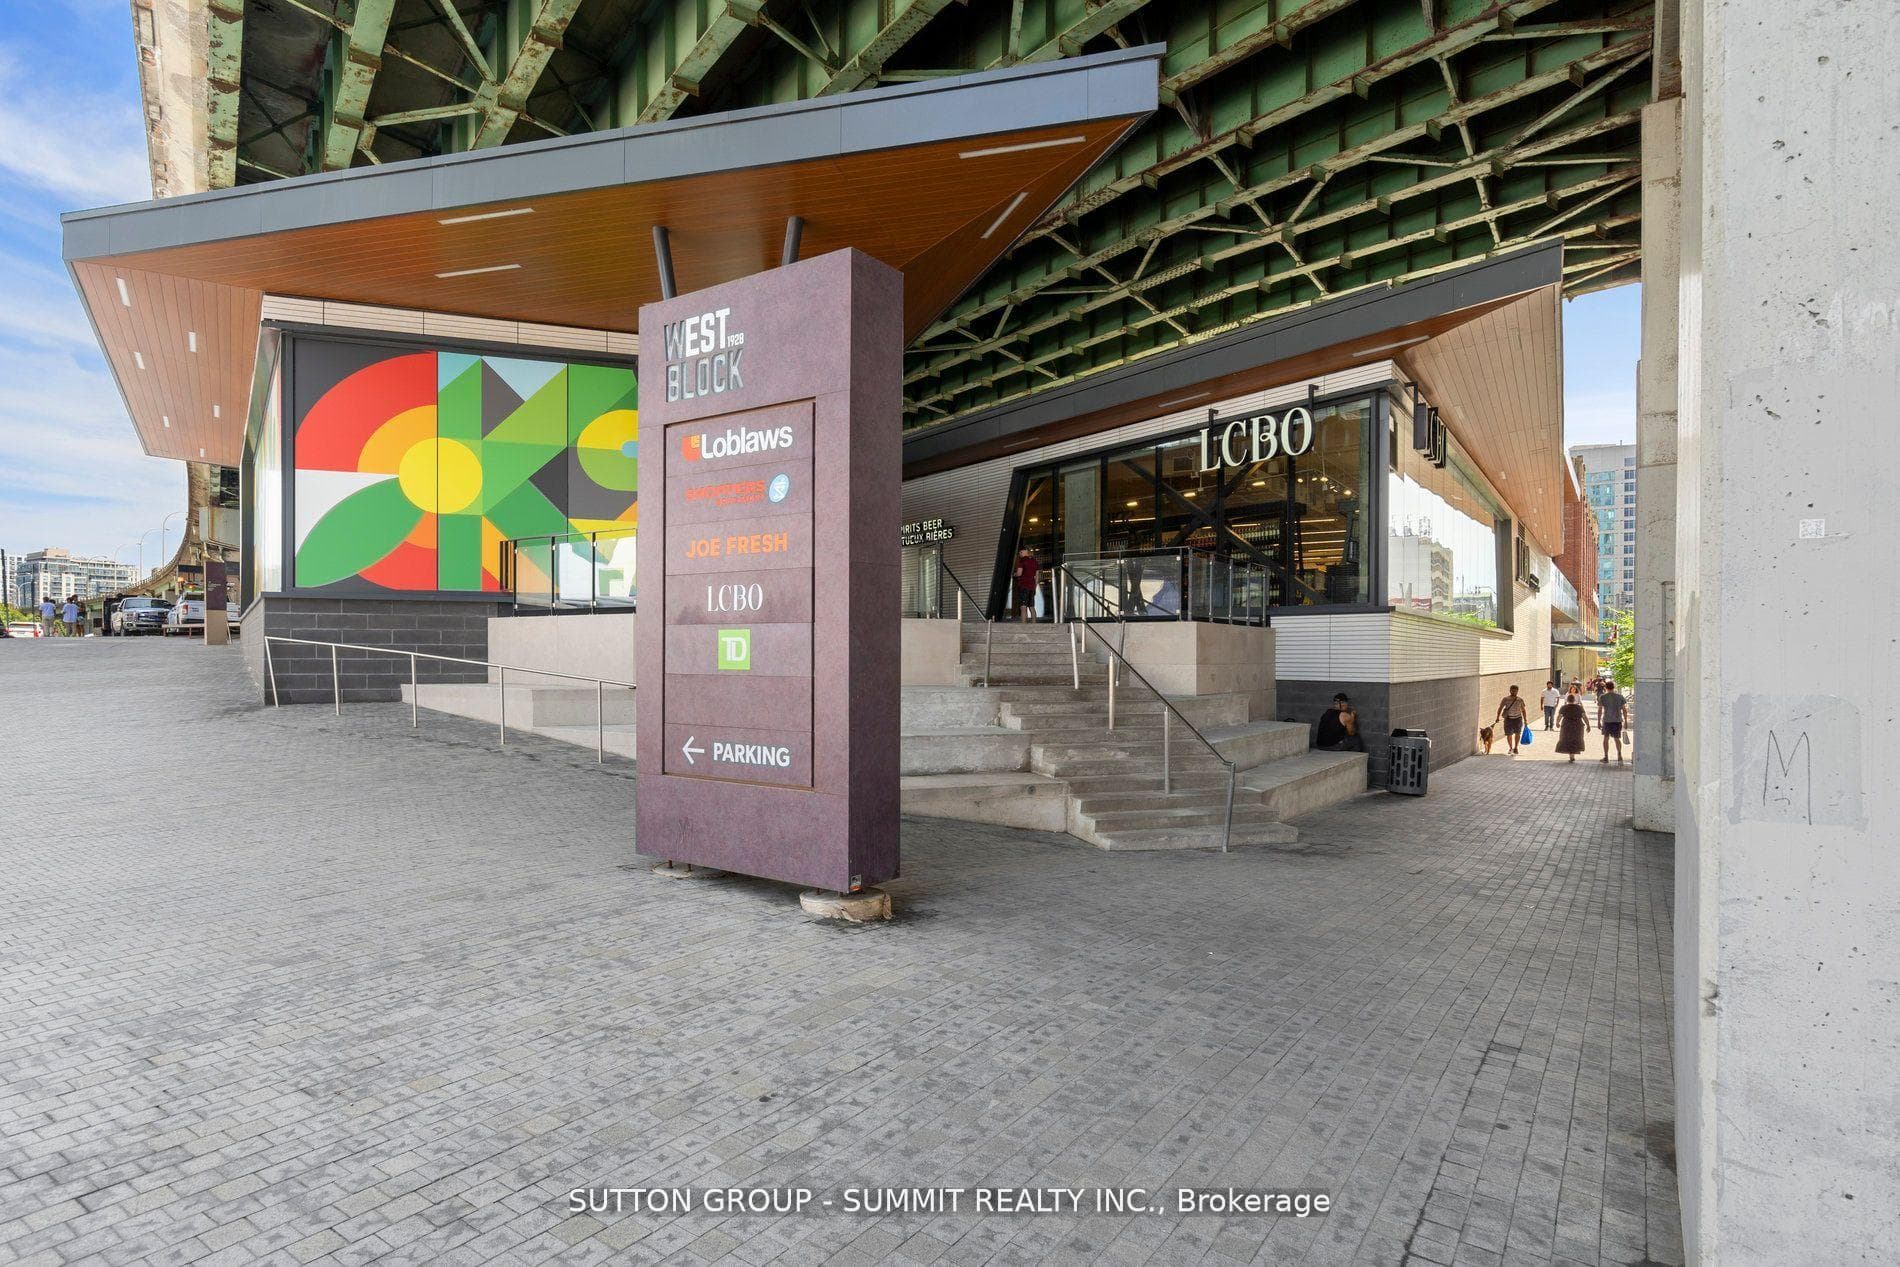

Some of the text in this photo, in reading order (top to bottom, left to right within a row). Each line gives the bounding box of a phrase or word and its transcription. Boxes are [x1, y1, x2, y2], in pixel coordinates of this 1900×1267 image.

[664, 308, 744, 361] WEST 1928
[666, 348, 744, 402] BLOCK
[701, 426, 793, 459] Loblaws
[1199, 407, 1312, 472] LCBO
[923, 519, 942, 530] BEER
[687, 532, 788, 559] JOE FRESH
[707, 583, 763, 612] LCBO
[721, 636, 747, 662] TD
[713, 742, 790, 767] PARKING
